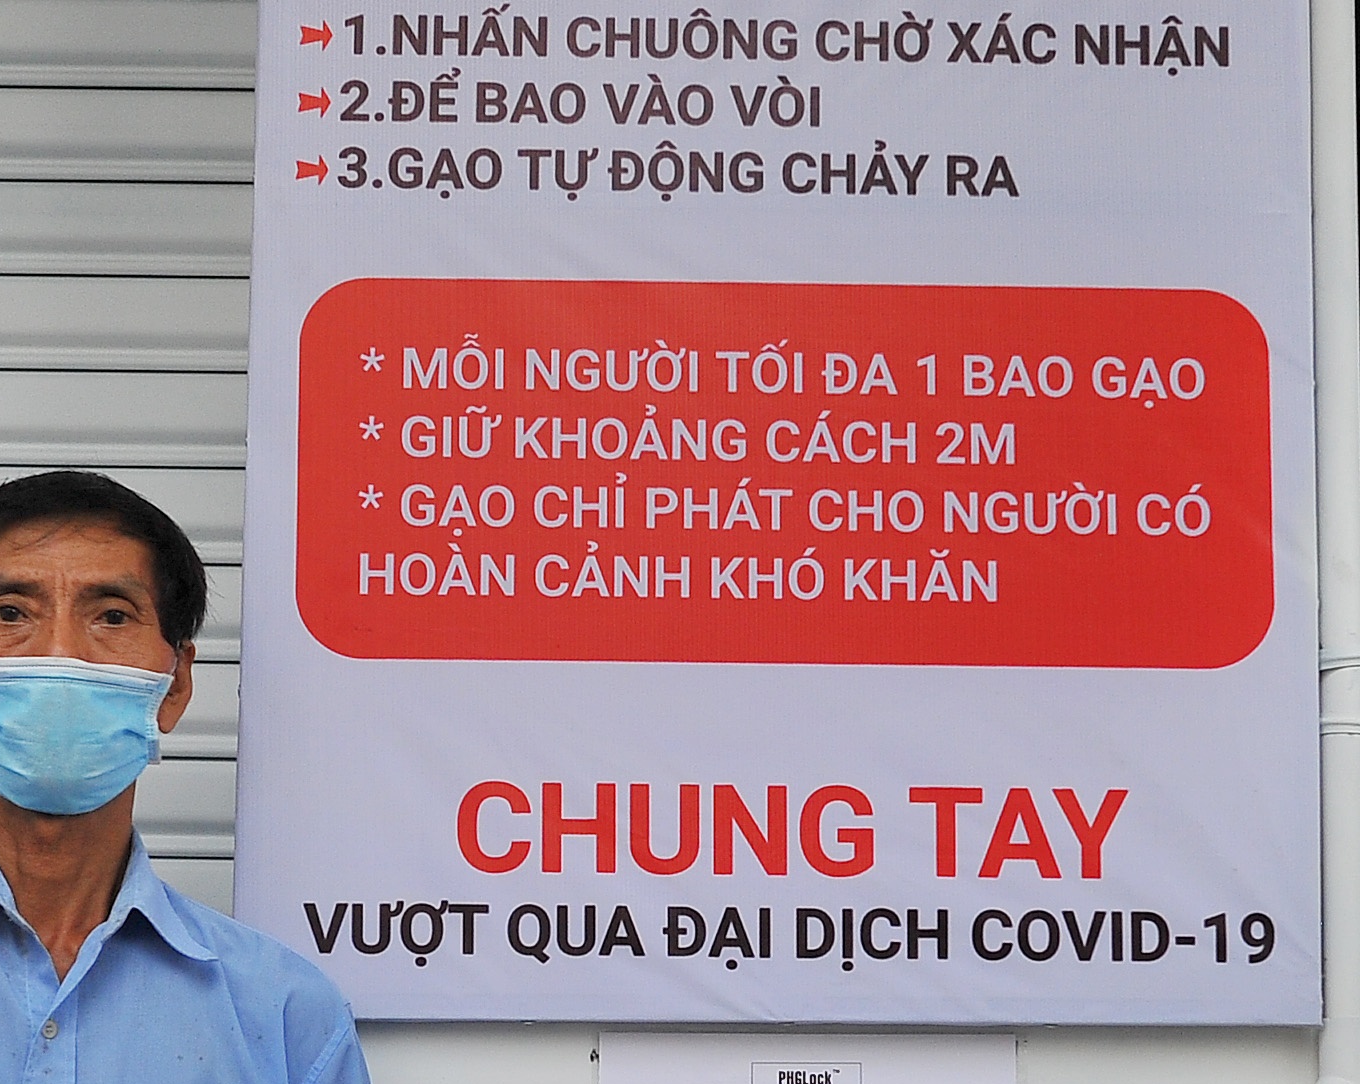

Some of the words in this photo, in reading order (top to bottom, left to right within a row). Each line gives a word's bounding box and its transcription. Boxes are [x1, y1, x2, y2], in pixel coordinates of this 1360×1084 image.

[344, 3, 549, 58] 1.NHẤN
[566, 7, 798, 62] CHUÔNG
[815, 10, 934, 63] CHỜ
[946, 12, 1057, 65] XÁC
[1074, 15, 1230, 75] NHẬN
[339, 67, 462, 123] 2.ĐỂ
[475, 81, 587, 125] BAO
[602, 73, 714, 127] VÀO
[729, 74, 821, 128] VÒI
[337, 146, 503, 200] 3.GẠO
[517, 147, 600, 202] TỰ
[607, 139, 764, 203] ĐỘNG
[781, 139, 930, 196] CHẢY
[946, 154, 1020, 198] RA
[403, 333, 504, 390] MỖI
[525, 337, 699, 392] NGƯỜI
[715, 339, 803, 394] TỐI
[821, 352, 898, 395] ĐA
[916, 354, 936, 395] 1
[963, 354, 1073, 398] BAO
[1092, 356, 1205, 409] GẠO
[401, 405, 502, 459] GIỮ
[515, 405, 747, 461] KHOẢNG
[766, 410, 916, 464] CÁCH
[935, 422, 1015, 465] 2M
[400, 483, 515, 537] GẠO
[533, 472, 627, 529] CHỈ
[646, 477, 793, 531] PHÁT
[809, 489, 924, 533] CHO
[943, 482, 1117, 535] NGƯỜI
[1137, 483, 1211, 537] CÓ
[359, 543, 515, 597] HOÀN
[535, 540, 690, 598] CẢNH
[711, 547, 825, 600] KHÓ
[844, 548, 997, 602] KHĂN
[457, 781, 875, 878] CHUNG
[909, 786, 1129, 879] TAY
[302, 899, 490, 968] VƯỢT
[507, 903, 646, 965] QUA
[662, 905, 772, 971] ĐẠI
[795, 907, 949, 972] DỊCH
[971, 908, 1276, 965] COVID-19
